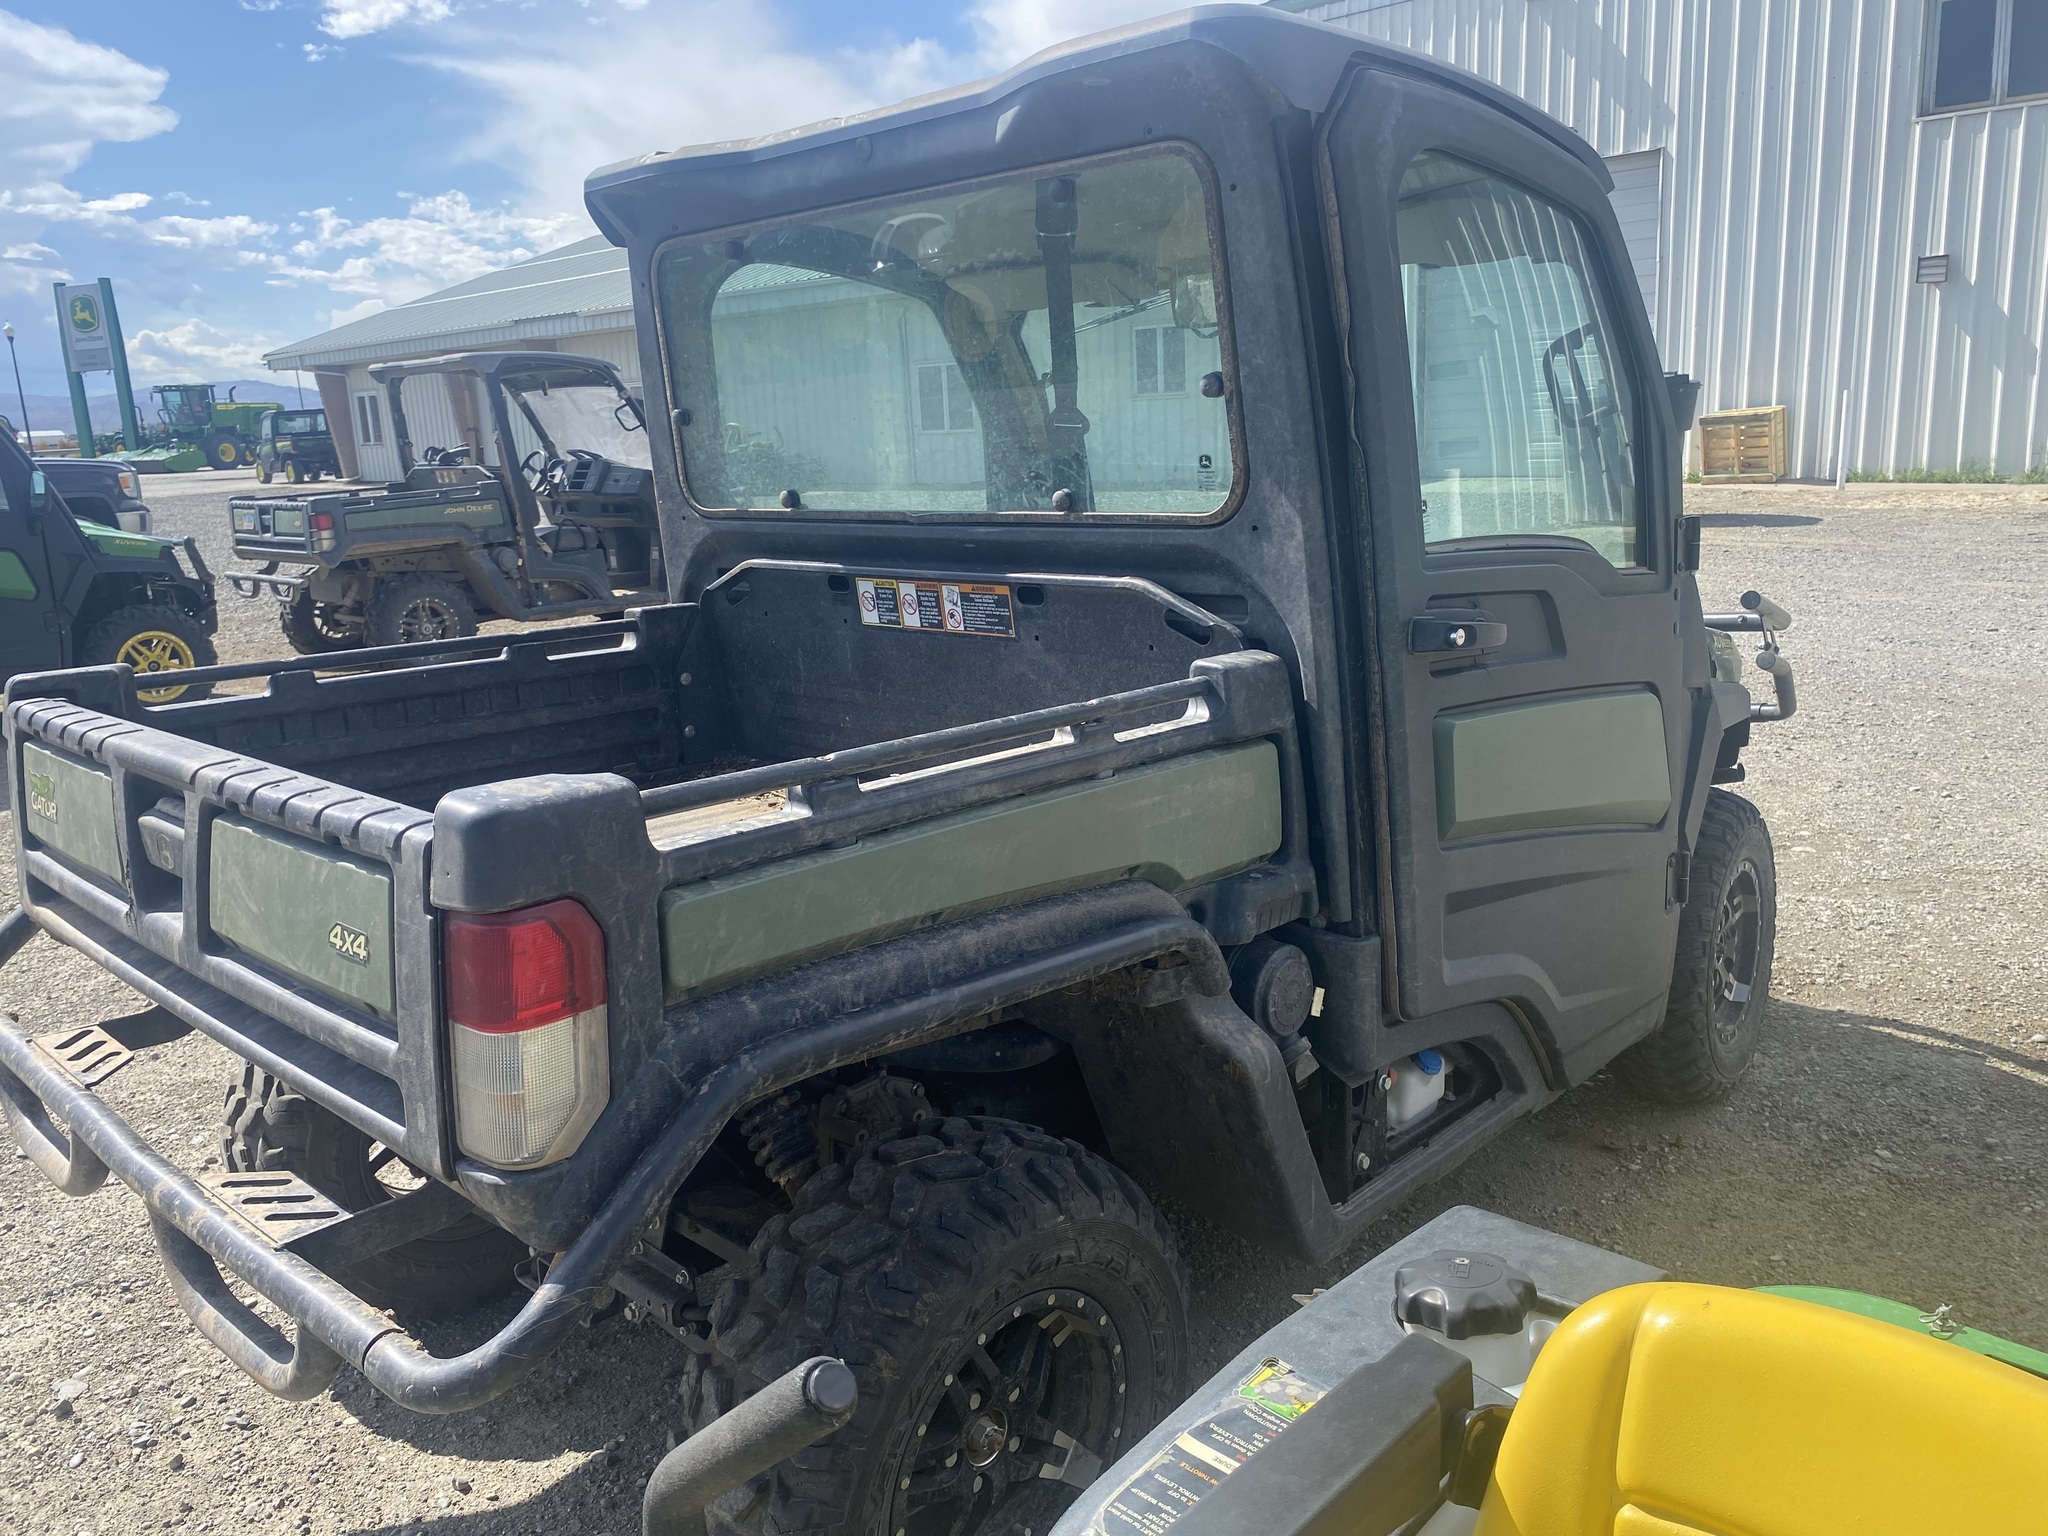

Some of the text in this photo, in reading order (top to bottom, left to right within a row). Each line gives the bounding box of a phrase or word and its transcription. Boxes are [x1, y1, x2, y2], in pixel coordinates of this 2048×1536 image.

[443, 503, 494, 515] JOHN DEERE
[31, 790, 57, 820] GATOR
[1242, 1408, 1278, 1430] SHUTDOWN
[1261, 1411, 1280, 1424] engine
[1208, 1422, 1233, 1438] LEVERS
[1252, 1431, 1263, 1440] ON
[1210, 1431, 1225, 1442] OFF
[1230, 1441, 1247, 1452] down
[1178, 1461, 1210, 1481] THROTTLE
[1153, 1472, 1178, 1489] LEVERS
[1166, 1489, 1181, 1498] OFF
[1106, 1505, 1121, 1517] start
[1112, 1500, 1128, 1512] start
[1156, 1501, 1177, 1515] engine
[1118, 1513, 1133, 1523] cold
[1125, 1508, 1142, 1520] warm
[1143, 1511, 1165, 1526] START
[1131, 1520, 1141, 1529] for
[1140, 1517, 1151, 1526] for
